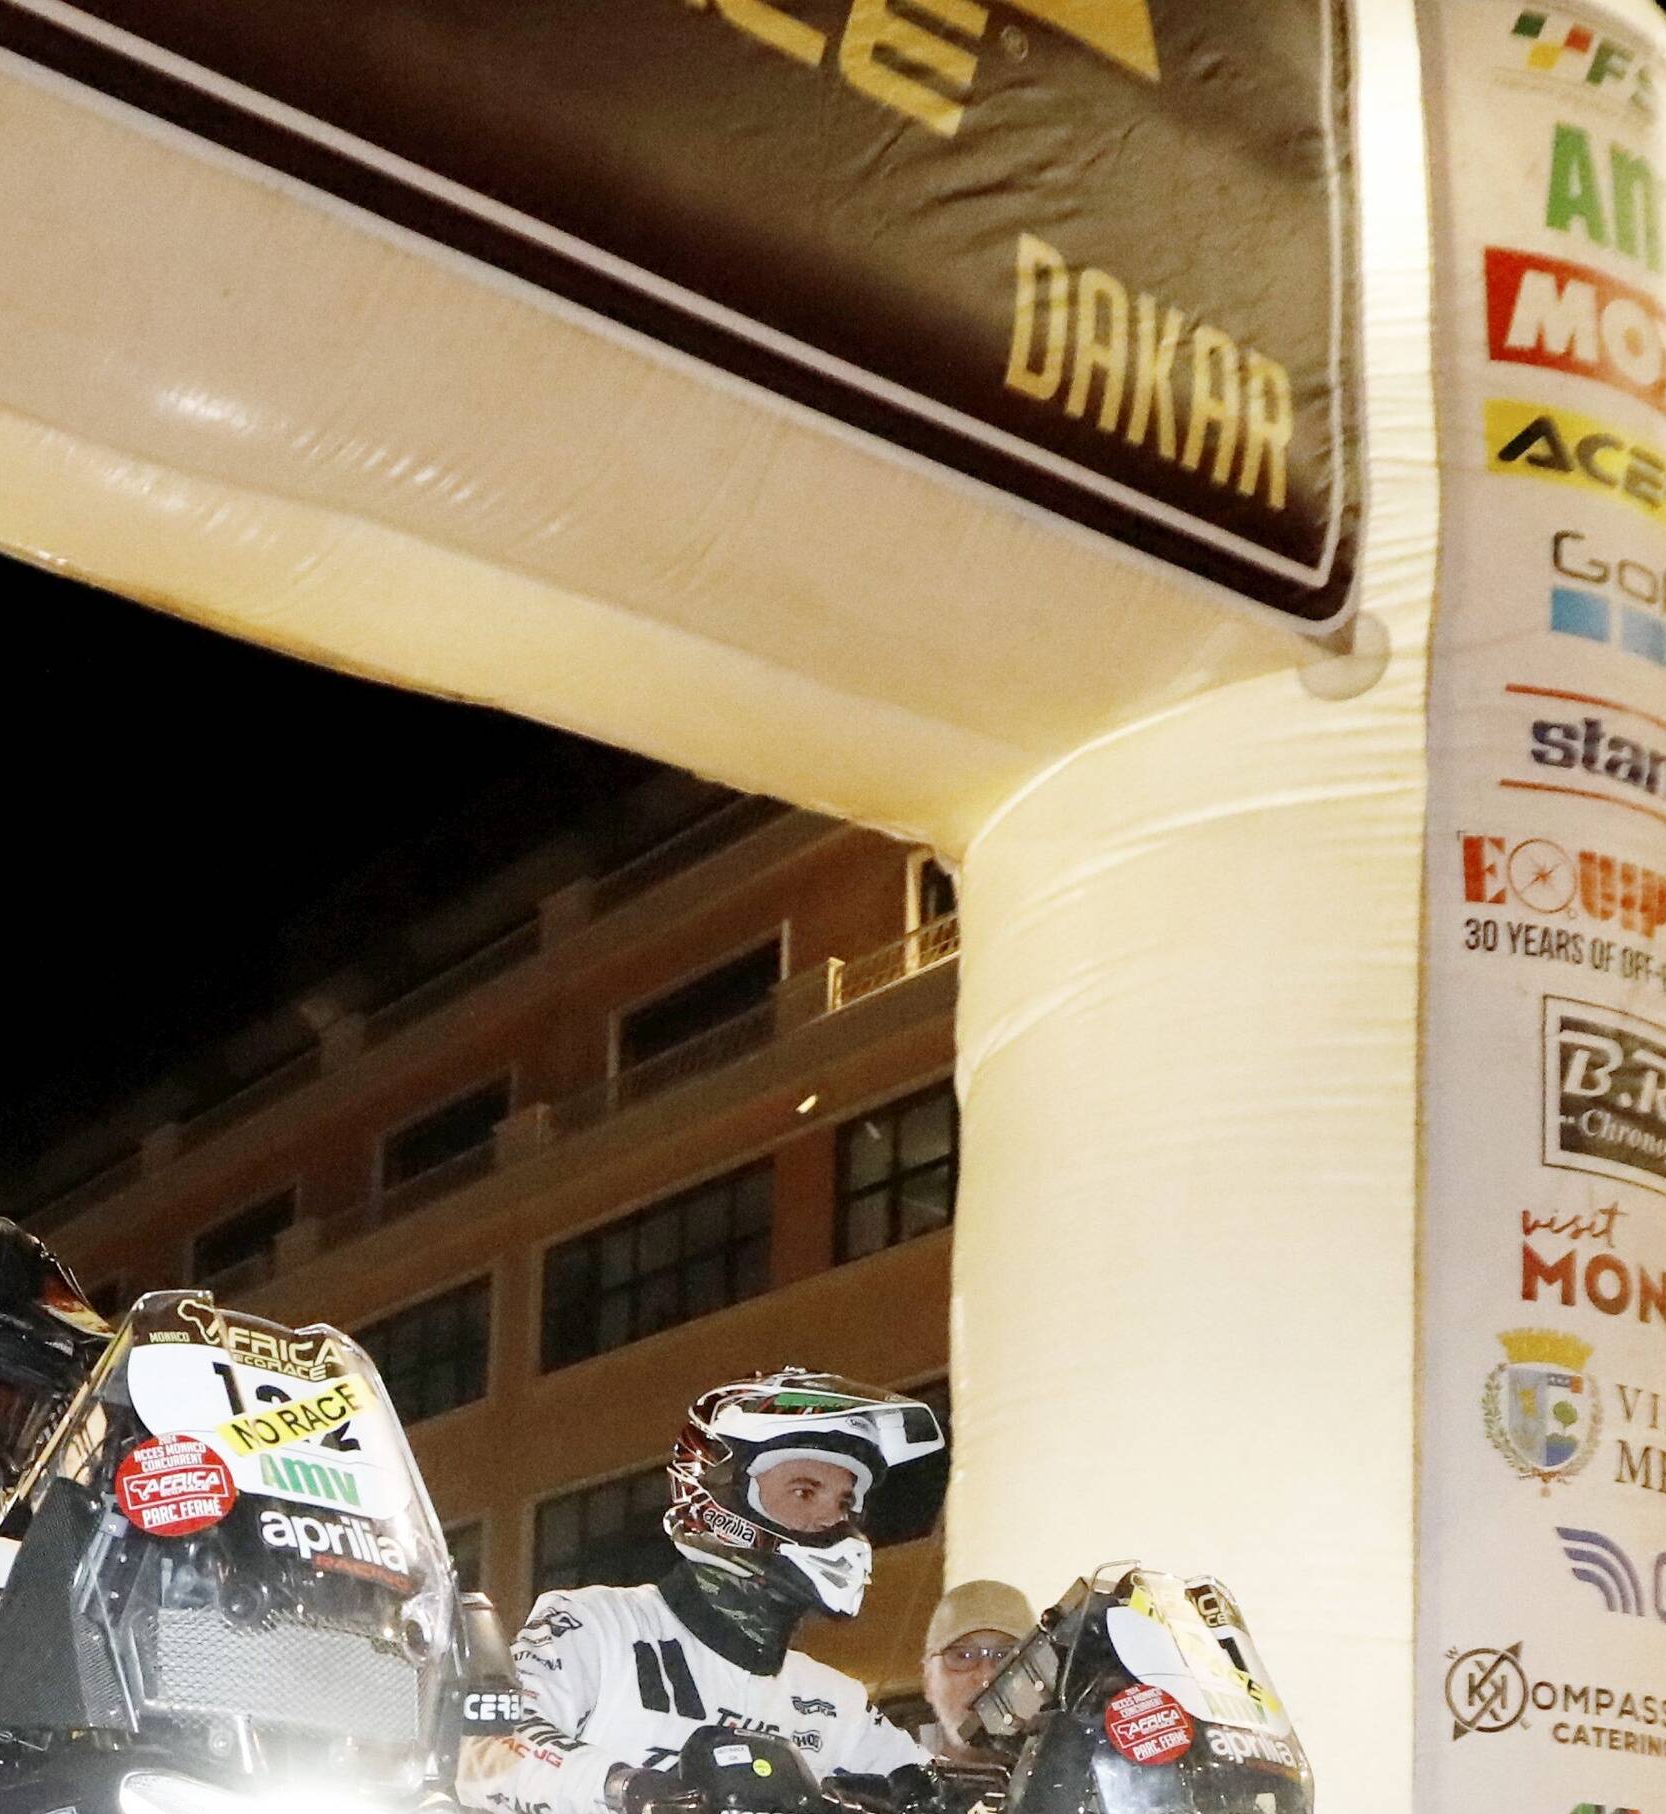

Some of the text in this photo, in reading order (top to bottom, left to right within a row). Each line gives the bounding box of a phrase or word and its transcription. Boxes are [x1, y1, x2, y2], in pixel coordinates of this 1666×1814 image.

[1005, 231, 1294, 511] DAKAR
[1464, 918, 1499, 952] 30
[1507, 920, 1585, 965] YEARS
[1590, 939, 1615, 972] OF
[1522, 1200, 1630, 1249] visit
[148, 1331, 191, 1344] MONACO
[231, 1382, 363, 1450] NO RACE
[142, 1503, 179, 1529] PARC
[704, 1509, 755, 1544] aprilia
[259, 1510, 410, 1576] aprilia
